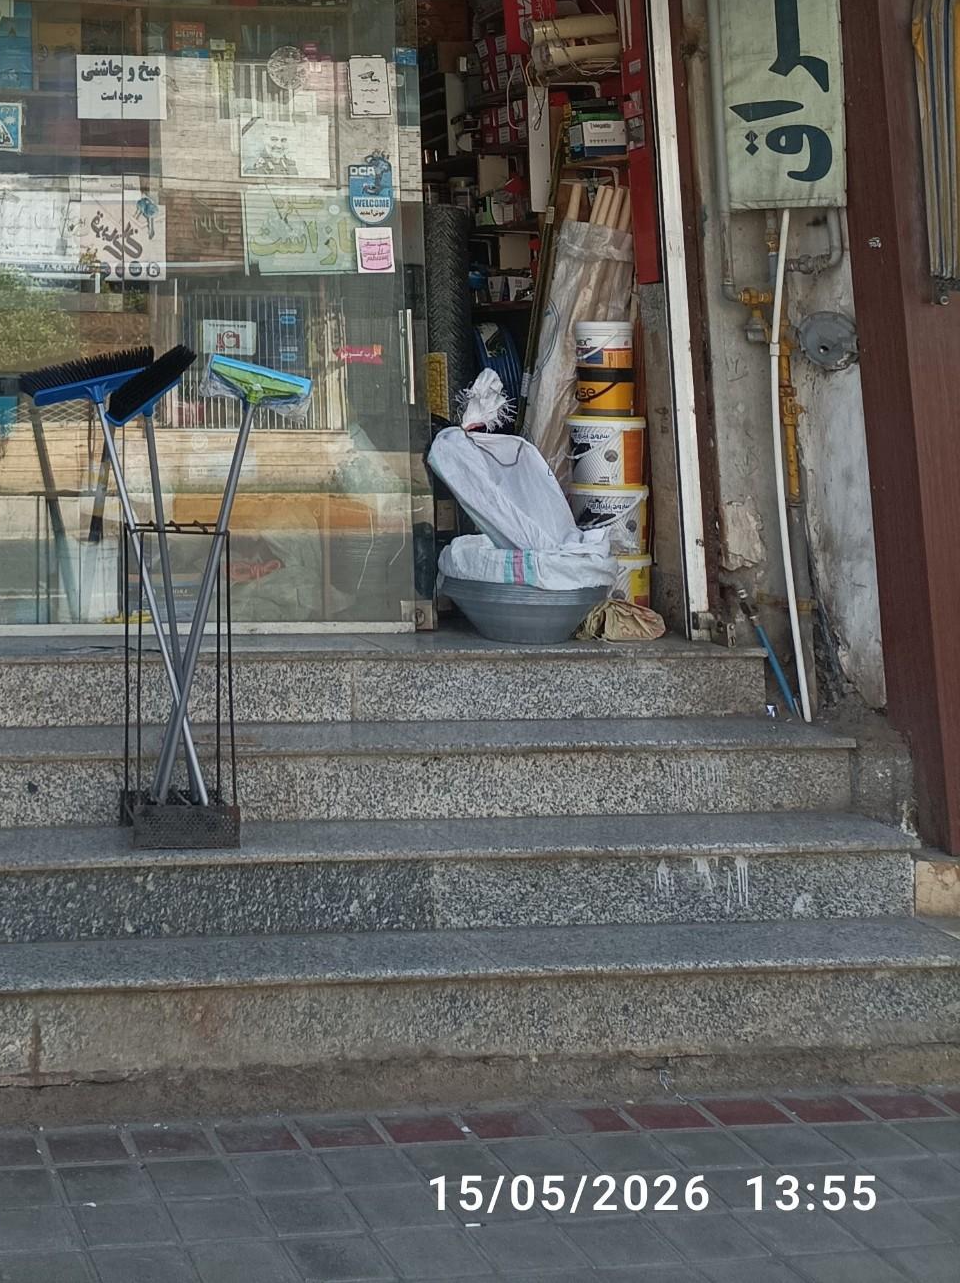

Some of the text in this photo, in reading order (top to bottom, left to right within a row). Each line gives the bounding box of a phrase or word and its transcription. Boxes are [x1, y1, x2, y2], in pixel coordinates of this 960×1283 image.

[80, 59, 161, 83] میخ و چاشنی
[100, 91, 143, 104] موجود است
[349, 166, 376, 176] DCA
[354, 198, 390, 208] WELCOME
